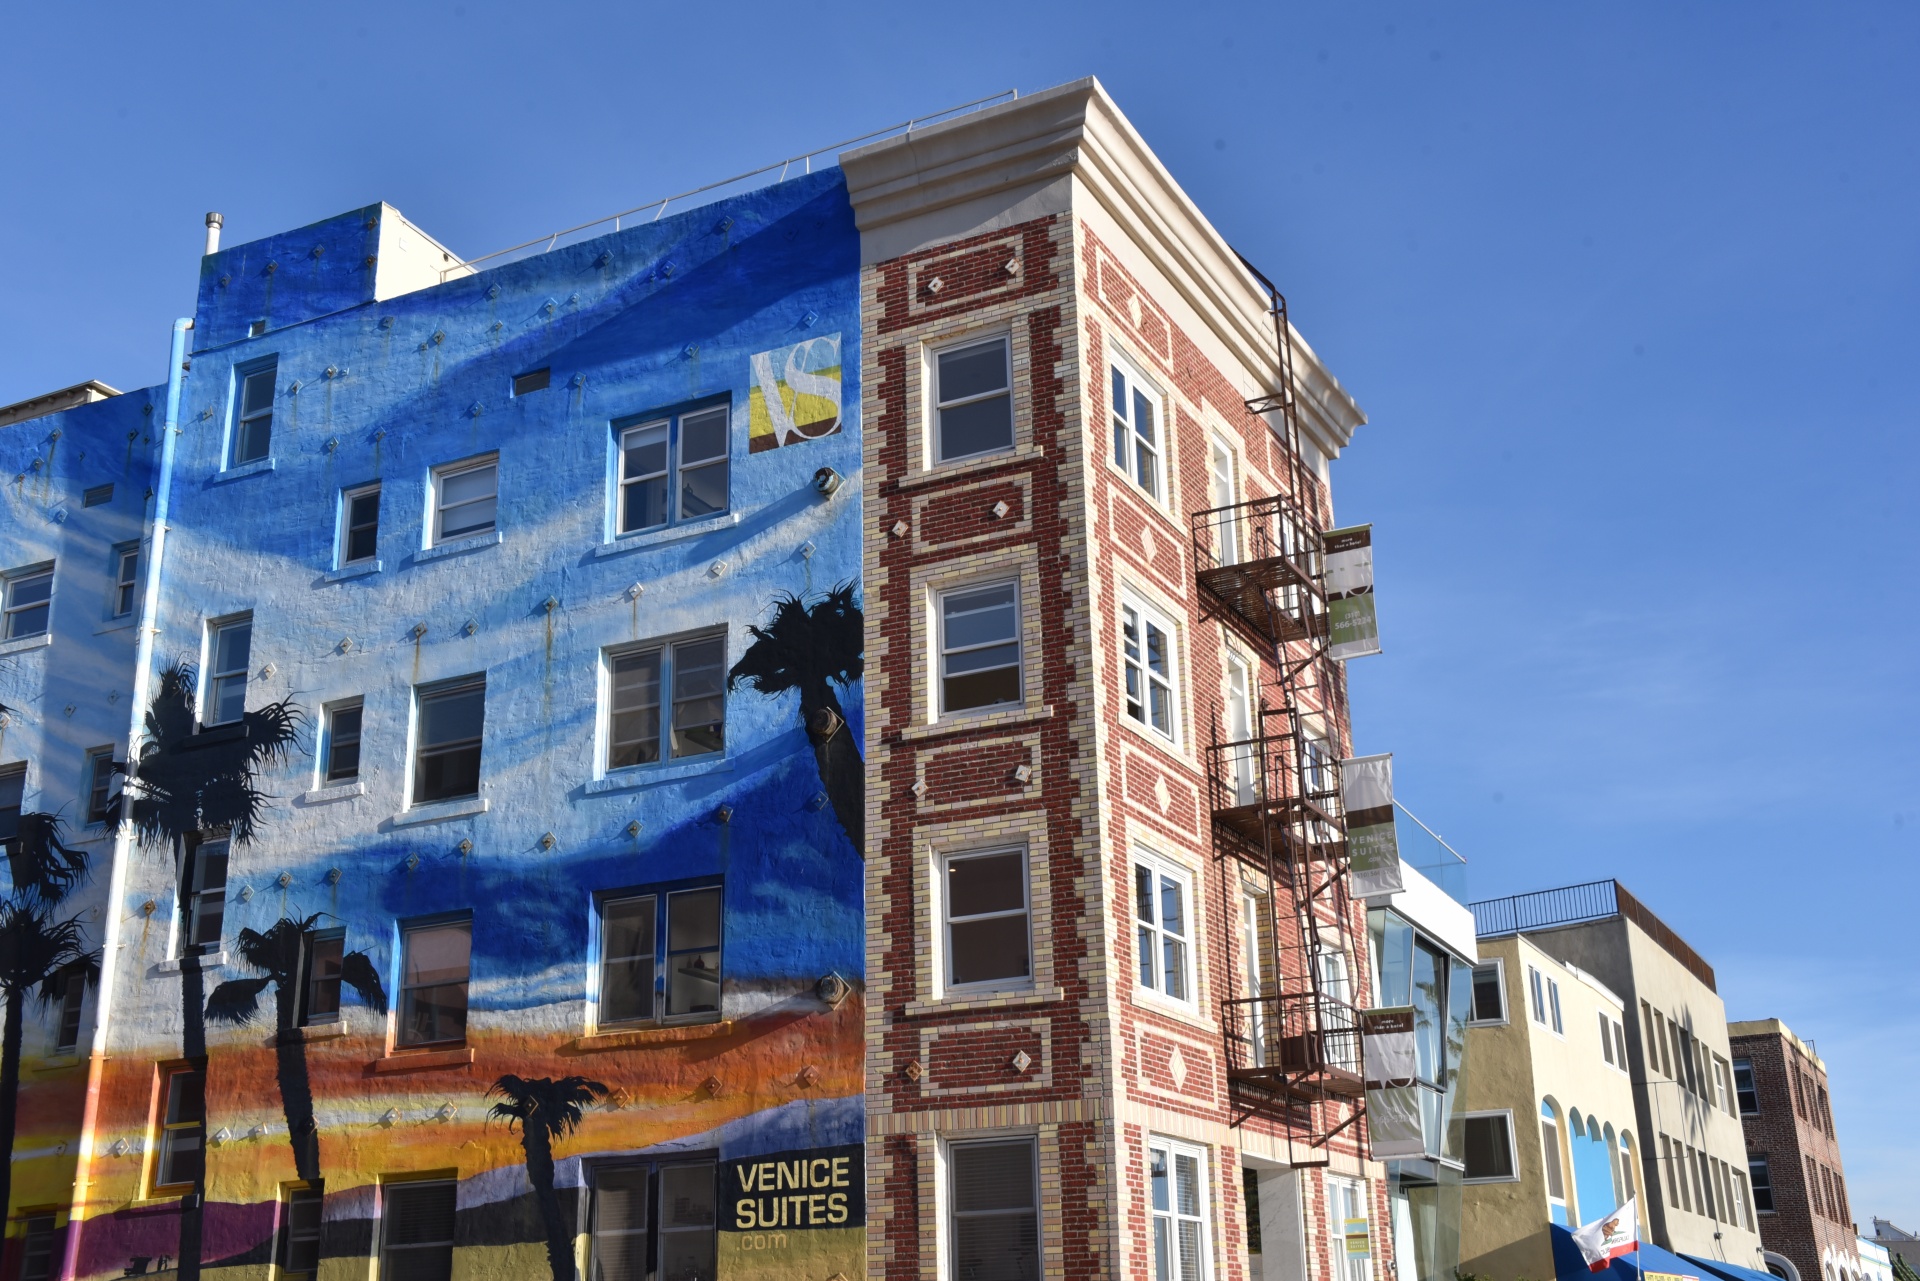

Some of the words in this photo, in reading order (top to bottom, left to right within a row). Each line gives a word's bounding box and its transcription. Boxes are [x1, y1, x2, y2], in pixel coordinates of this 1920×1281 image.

[1350, 831, 1393, 845] VENICE
[1351, 842, 1394, 857] SUITES
[736, 1156, 850, 1193] VENICE
[735, 1192, 849, 1229] SUITES
[735, 1232, 788, 1251] .com
